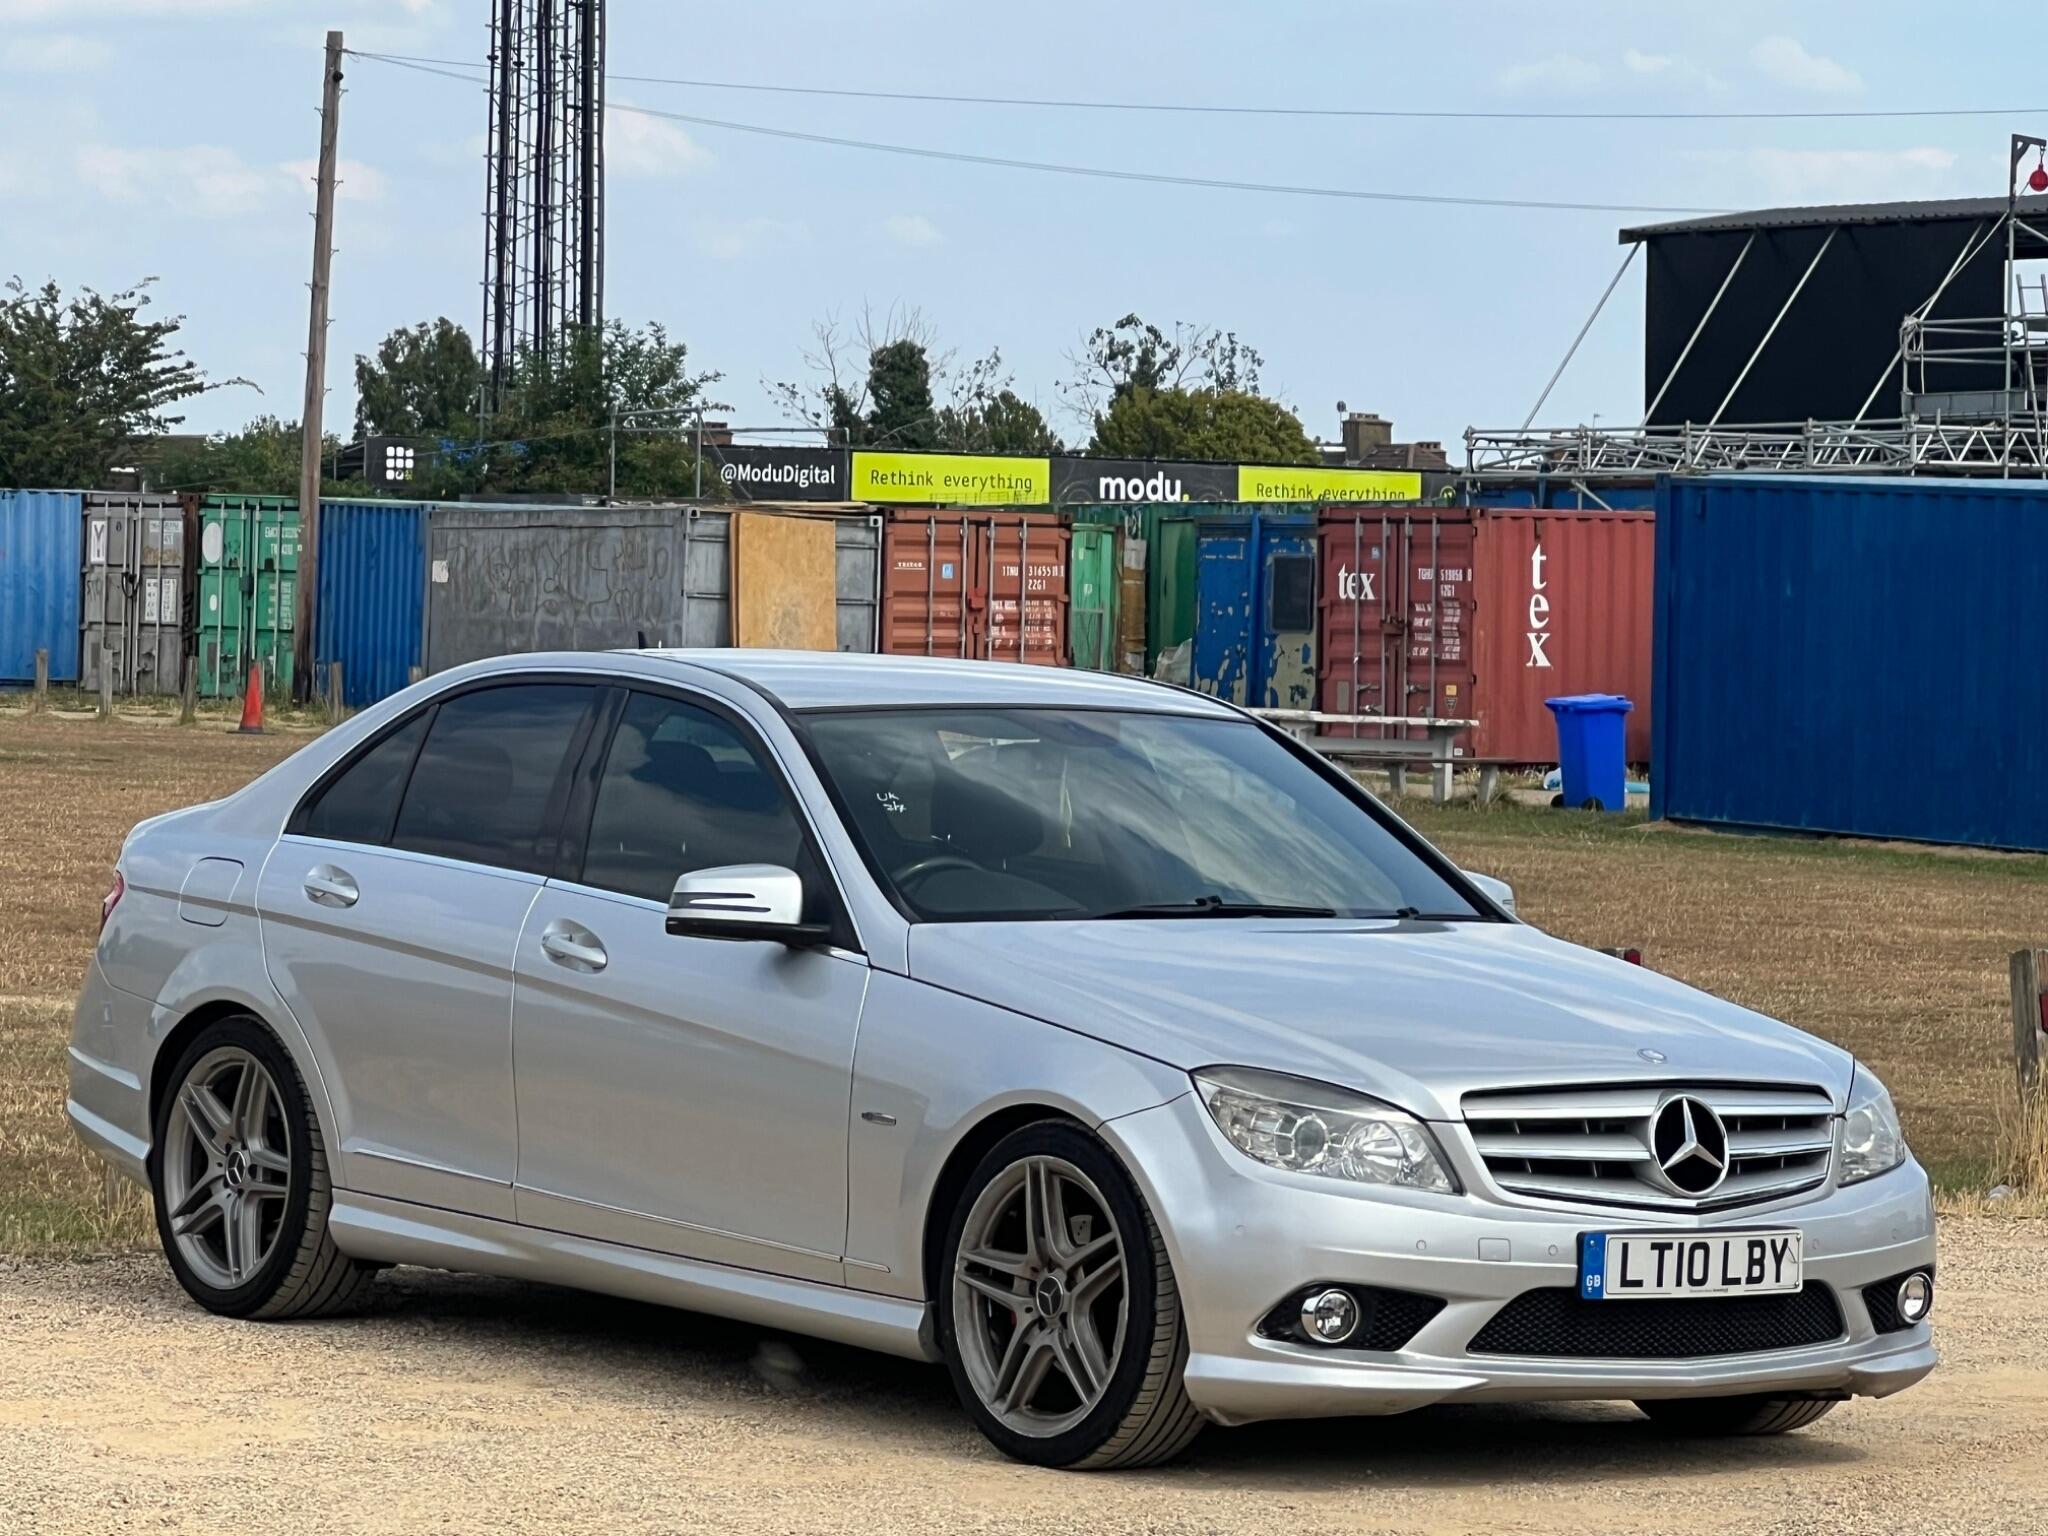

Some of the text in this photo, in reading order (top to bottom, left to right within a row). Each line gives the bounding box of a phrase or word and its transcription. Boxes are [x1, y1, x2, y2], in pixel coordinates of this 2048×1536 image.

[720, 463, 835, 488] @ModuDigital
[870, 469, 1033, 493] Rethink everything
[1256, 483, 1313, 499] Rethink
[1338, 563, 1375, 600] tex
[1526, 543, 1551, 668] tex
[1620, 1238, 1789, 1288] LT10 LBY
[1586, 1274, 1601, 1287] GB
